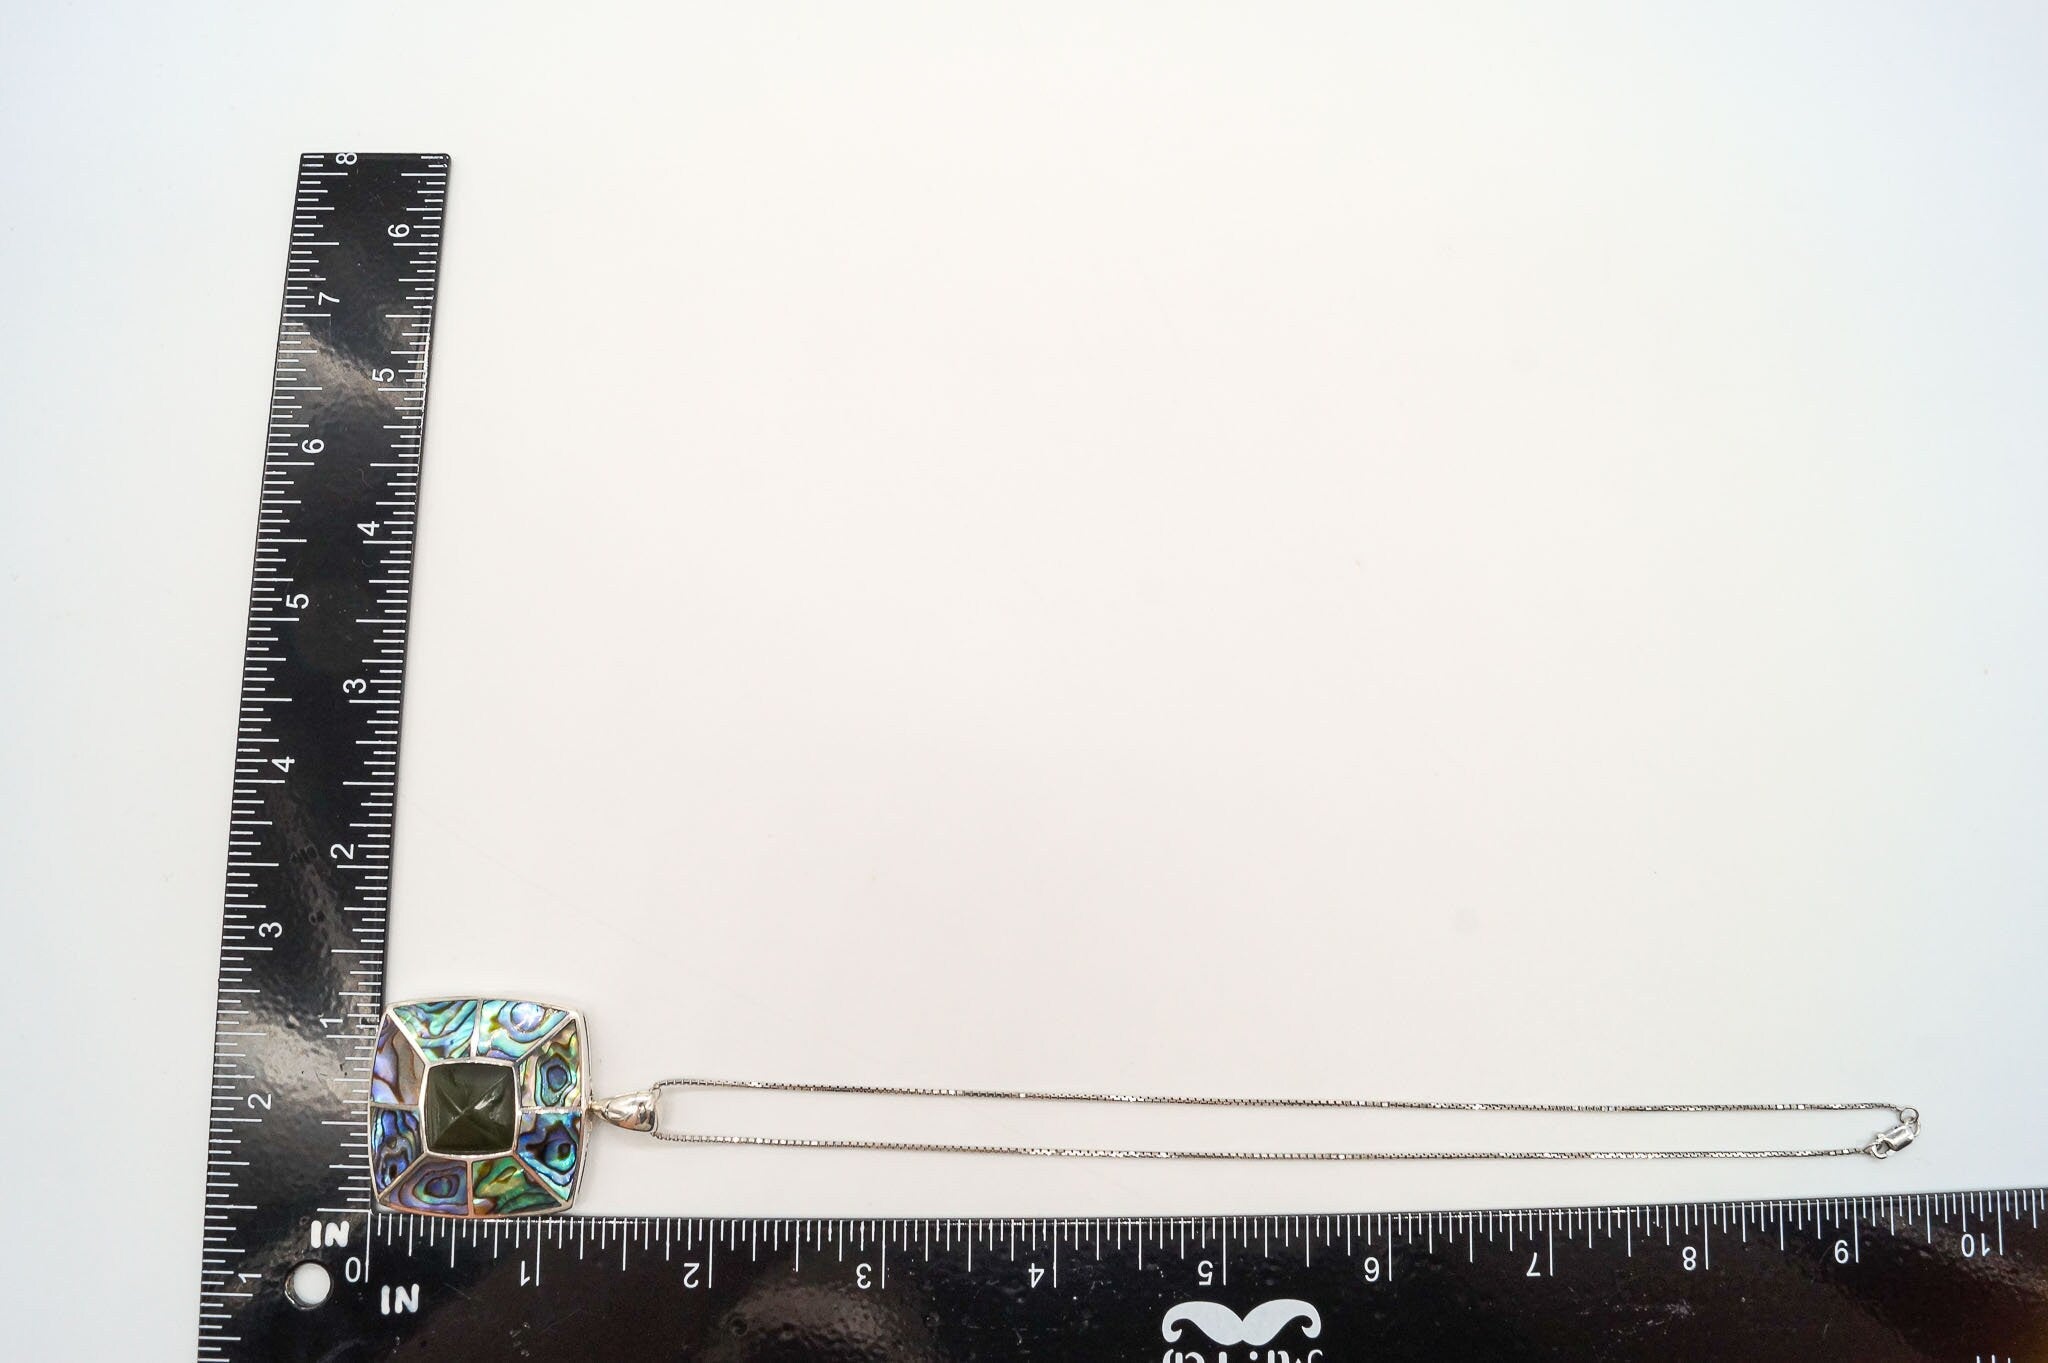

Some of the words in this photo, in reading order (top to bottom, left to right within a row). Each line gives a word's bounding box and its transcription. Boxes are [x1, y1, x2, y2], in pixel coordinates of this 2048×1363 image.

[336, 152, 358, 165] 8
[388, 223, 410, 238] 6
[318, 291, 340, 306] 7
[372, 368, 394, 383] 5
[301, 438, 325, 454] 6
[357, 520, 379, 536] 4
[286, 593, 309, 609] 5
[343, 678, 366, 694] 3
[272, 756, 295, 772] 4
[331, 843, 354, 859] 2
[259, 922, 282, 938] 3
[319, 1015, 343, 1029] 1
[248, 1093, 271, 1110] 2
[311, 1221, 349, 1248] IN
[1835, 1240, 1849, 1263] 9
[1962, 1233, 1990, 1257] 10
[1526, 1253, 1541, 1277] 7
[1683, 1247, 1697, 1270] 8
[346, 1257, 361, 1283] 0
[521, 1261, 530, 1286] 1
[684, 1263, 699, 1288] 2
[856, 1263, 871, 1289] 3
[1029, 1263, 1044, 1288] 4
[1198, 1261, 1213, 1285] 5
[1364, 1257, 1380, 1282] 6
[238, 1273, 261, 1284] 1
[381, 1284, 419, 1314] IN
